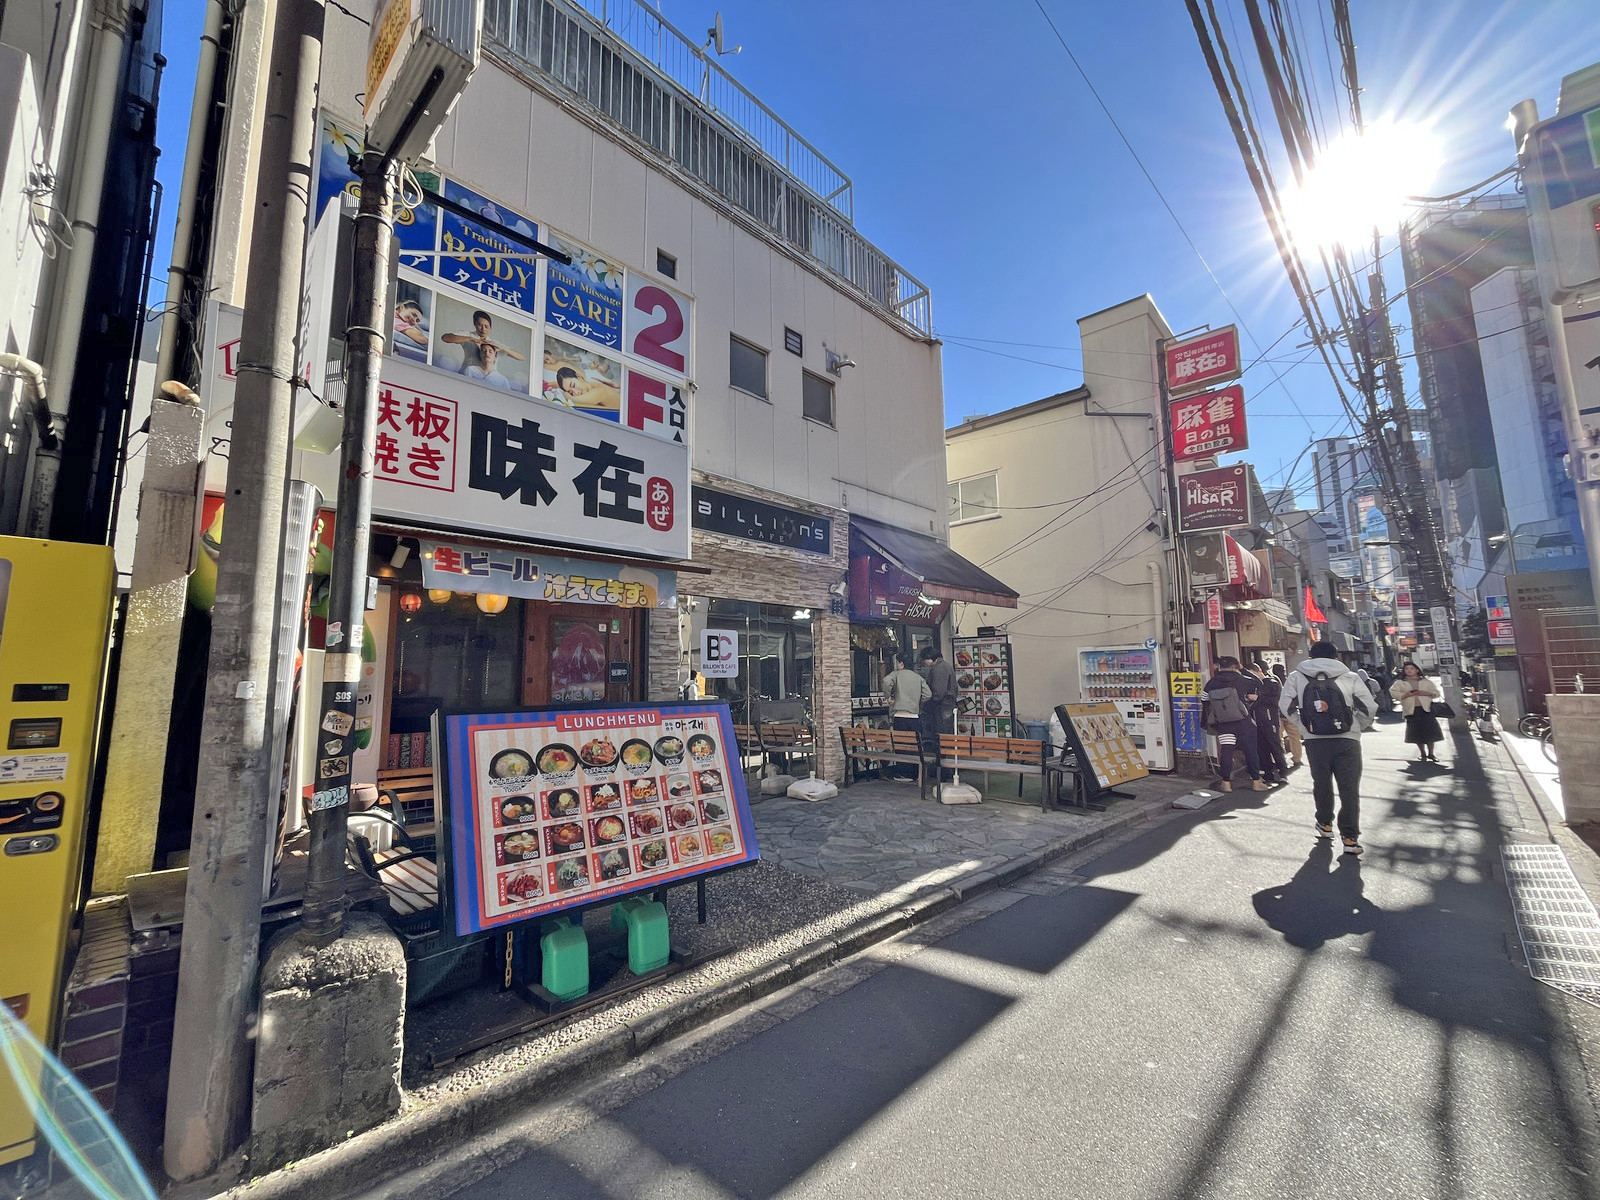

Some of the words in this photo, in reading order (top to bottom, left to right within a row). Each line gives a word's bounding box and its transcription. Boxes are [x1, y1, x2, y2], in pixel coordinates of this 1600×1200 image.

[443, 231, 533, 289] BODY
[455, 268, 522, 309] タイ古式
[549, 268, 576, 286] Thai
[580, 280, 622, 306] Massage
[552, 287, 618, 330] CARE
[552, 311, 618, 346] マッサージ
[1176, 352, 1217, 378] 味在
[669, 387, 686, 430] 入口
[1177, 396, 1235, 430] 麻雀
[1185, 424, 1230, 444] 日の出
[468, 411, 645, 525] 味在
[650, 481, 670, 528] あぜ
[748, 529, 784, 543] CAFE
[434, 547, 538, 582] 生ビール
[544, 573, 648, 605] 冷えてます。
[905, 603, 933, 619] HISAR
[336, 692, 351, 700] SOS
[1174, 684, 1193, 695] 2F
